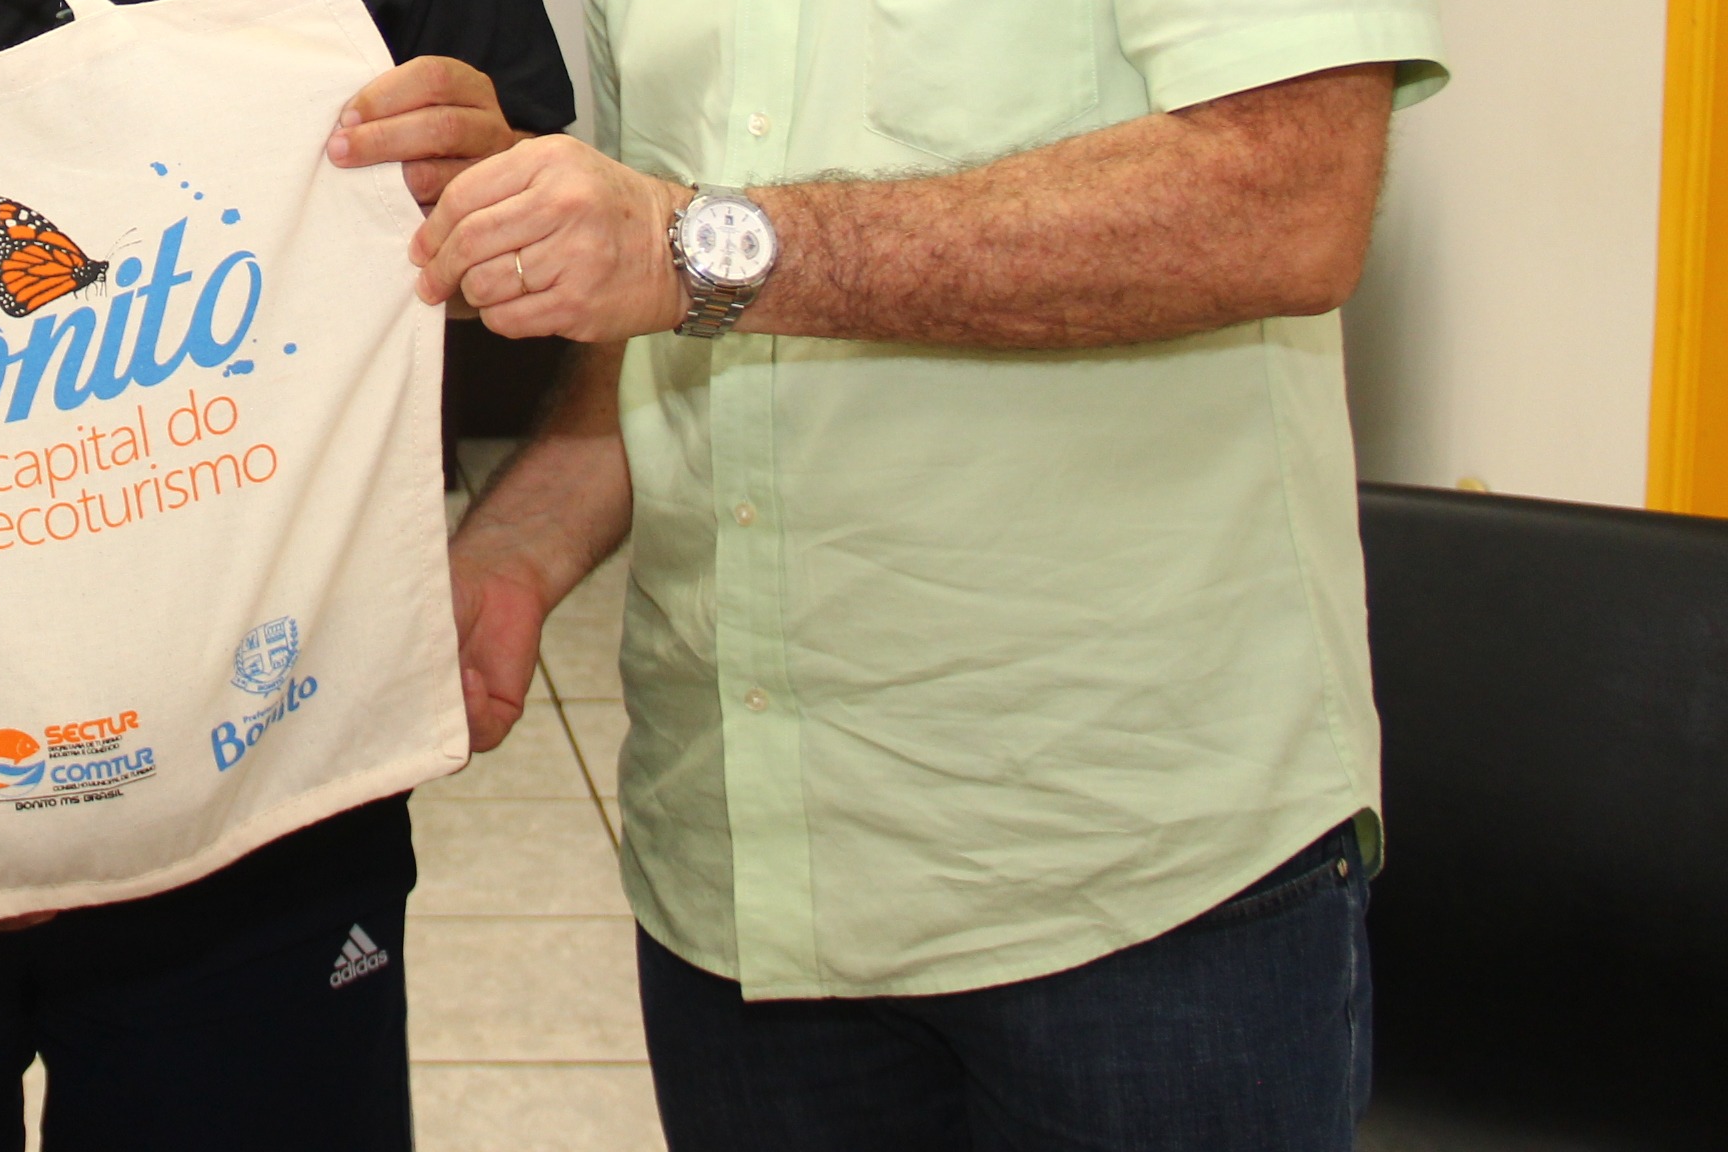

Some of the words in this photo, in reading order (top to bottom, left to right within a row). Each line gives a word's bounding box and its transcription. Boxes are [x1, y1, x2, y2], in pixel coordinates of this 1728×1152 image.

[167, 389, 238, 448] do
[44, 710, 139, 745] SECTUR
[51, 747, 154, 783] COMTUR
[15, 798, 57, 811] BONITO
[60, 796, 80, 806] MS
[83, 789, 124, 803] BRASIL
[329, 950, 388, 988] adidas
